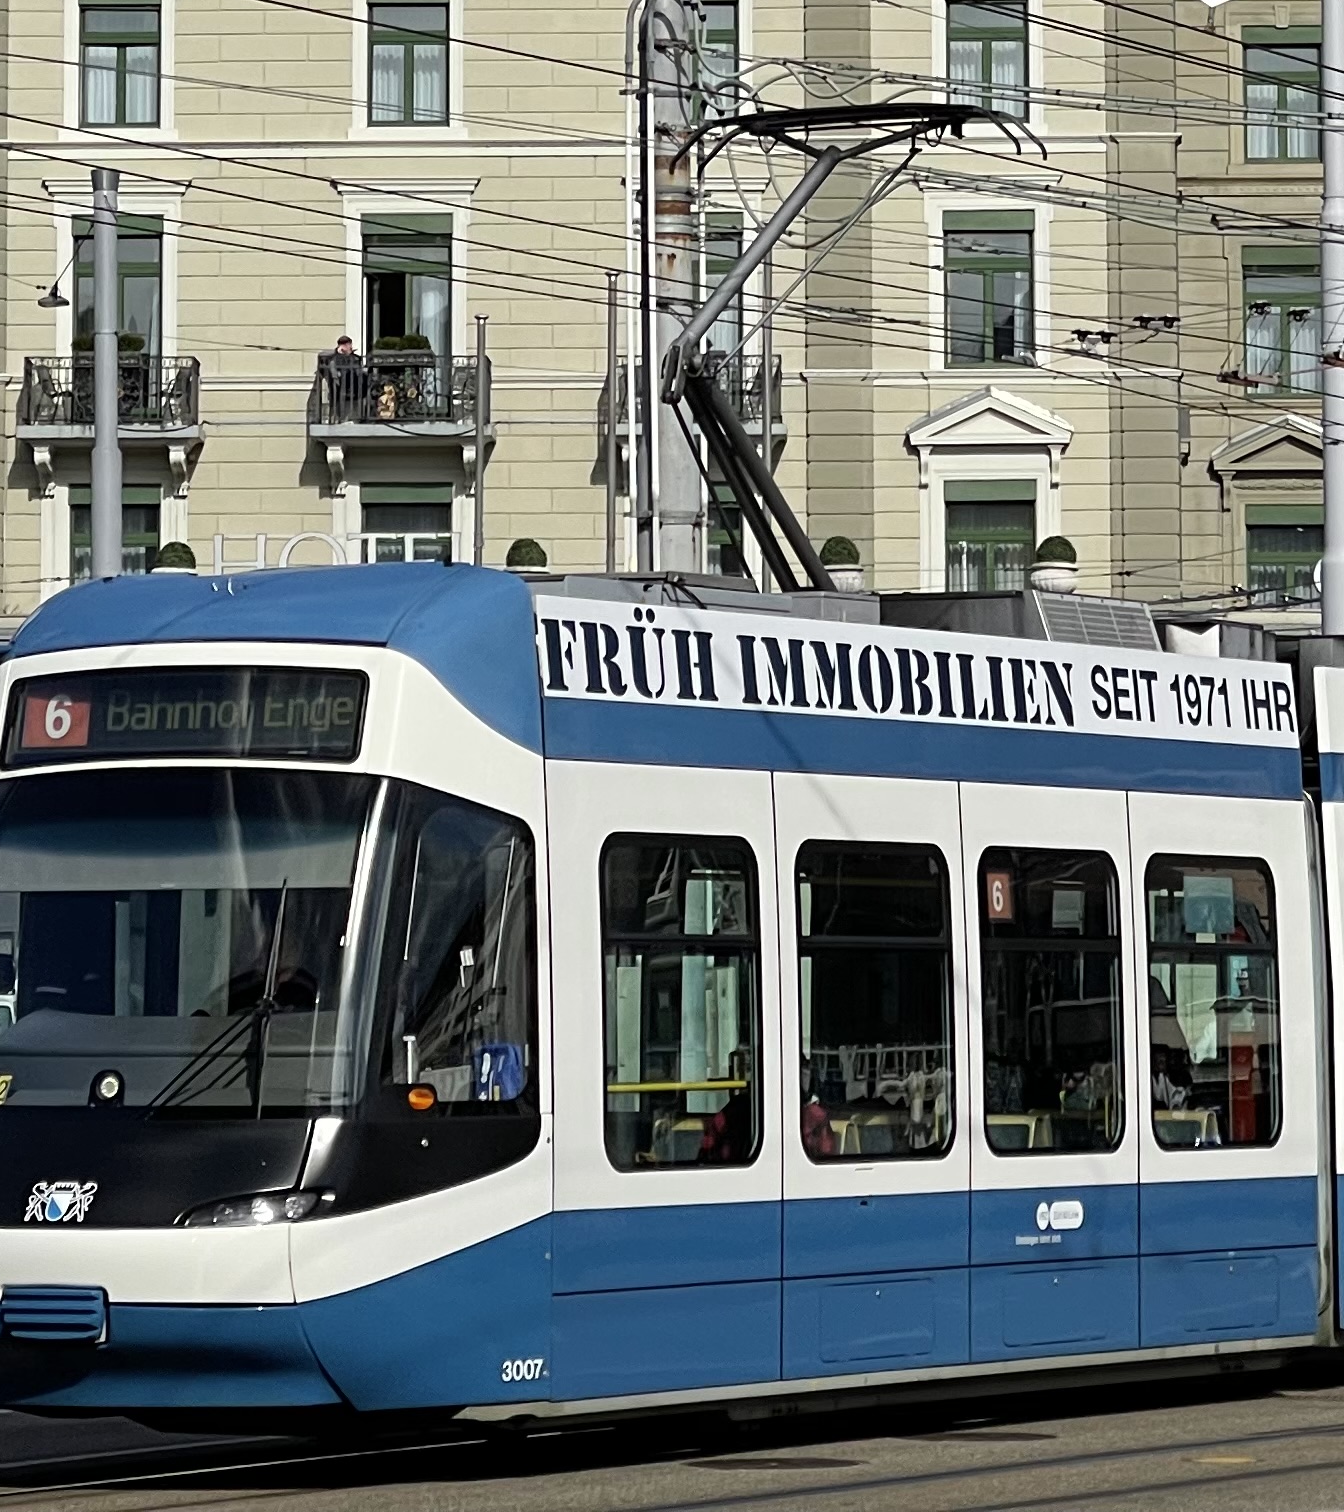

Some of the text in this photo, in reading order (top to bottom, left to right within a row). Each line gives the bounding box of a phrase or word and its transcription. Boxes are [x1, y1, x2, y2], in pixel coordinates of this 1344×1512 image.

[541, 607, 1295, 733] FRÜH IMMOBILIEN SEIT 1971 IHR
[44, 694, 73, 740] 6
[992, 880, 1004, 913] 6
[501, 1358, 544, 1383] 3007
